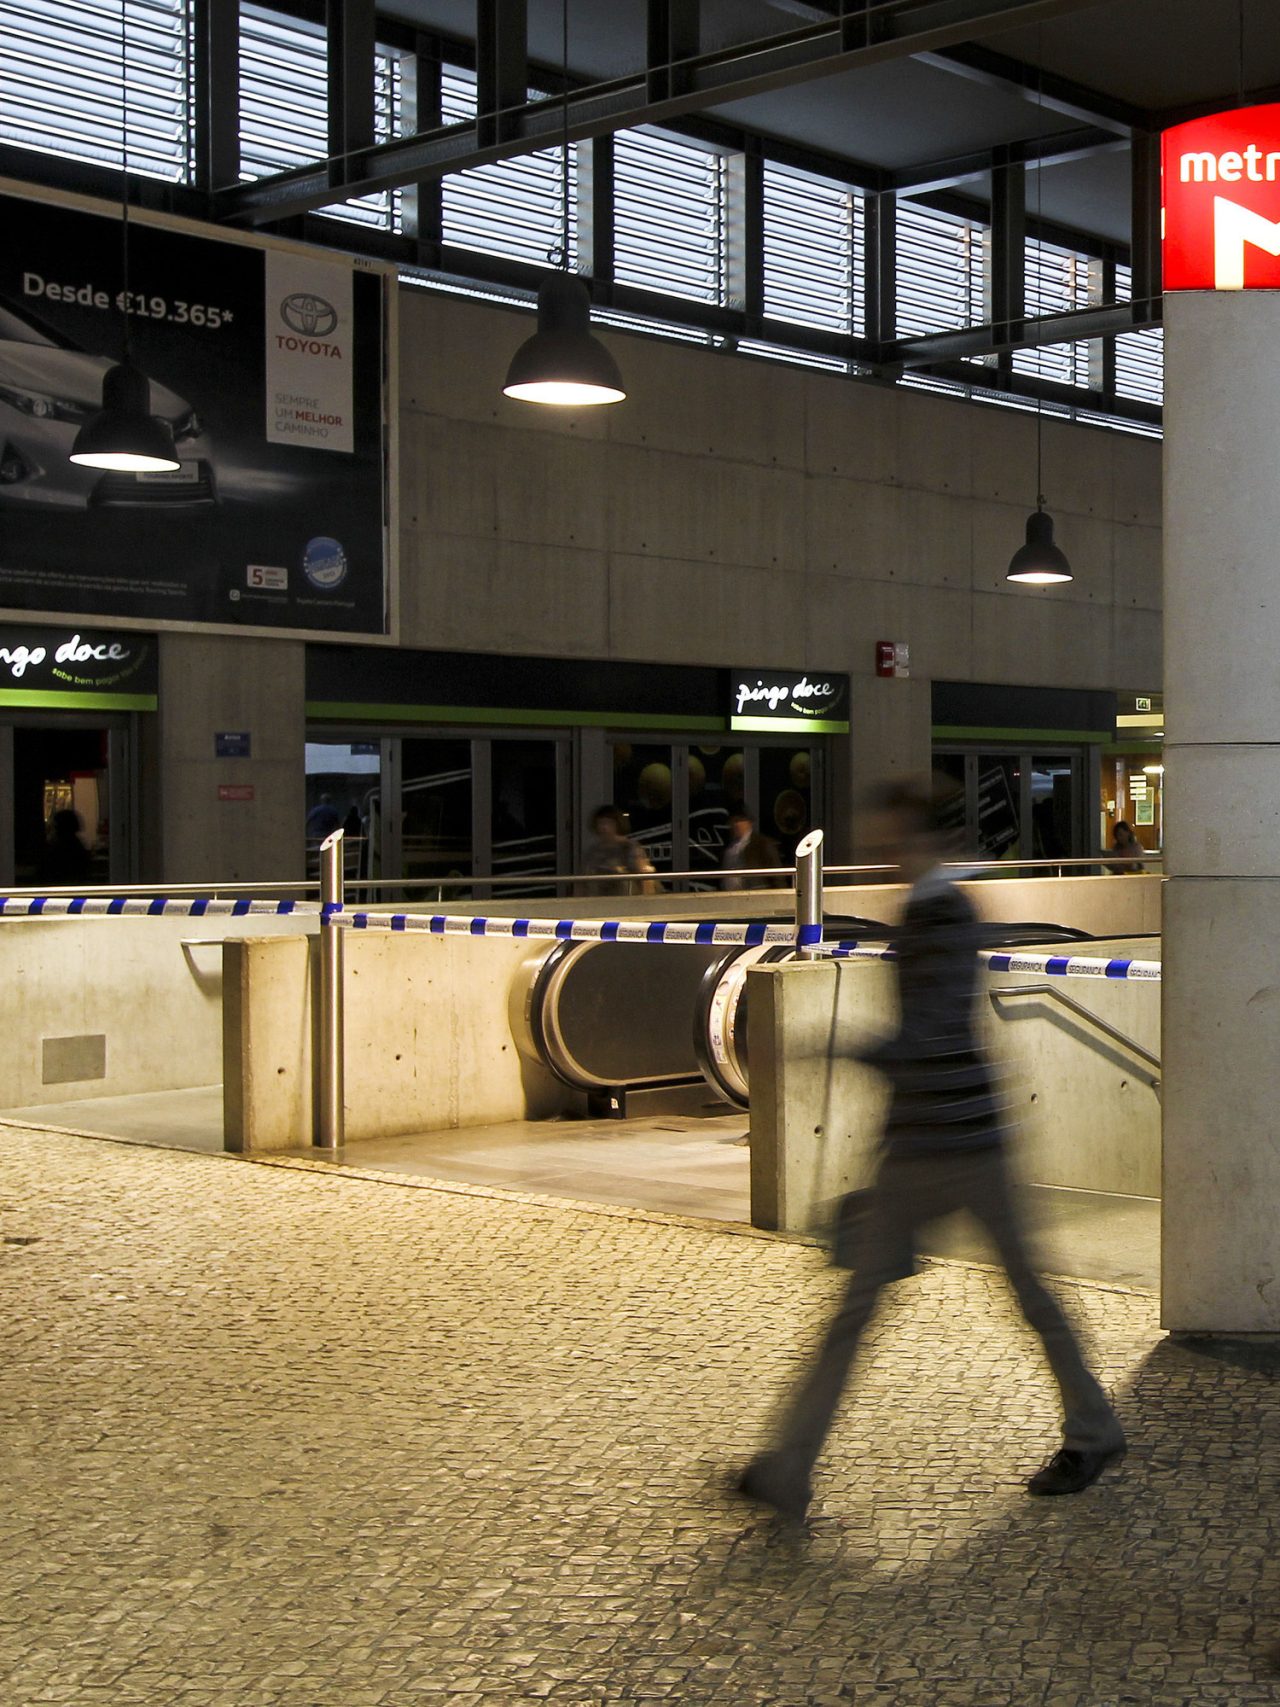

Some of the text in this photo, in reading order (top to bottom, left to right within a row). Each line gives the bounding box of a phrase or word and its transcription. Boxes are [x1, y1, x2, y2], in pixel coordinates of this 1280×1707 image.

[23, 272, 109, 309] Desde
[275, 336, 342, 359] TOYOTA
[275, 392, 319, 409] SEMPRE
[275, 407, 343, 427] UM MELHOR
[275, 421, 329, 438] CAMINHO
[252, 568, 263, 586] 5
[54, 634, 130, 664] doce
[51, 667, 73, 682] sabe
[74, 675, 93, 685] bem
[736, 680, 789, 714] pingo
[792, 677, 835, 699] doce
